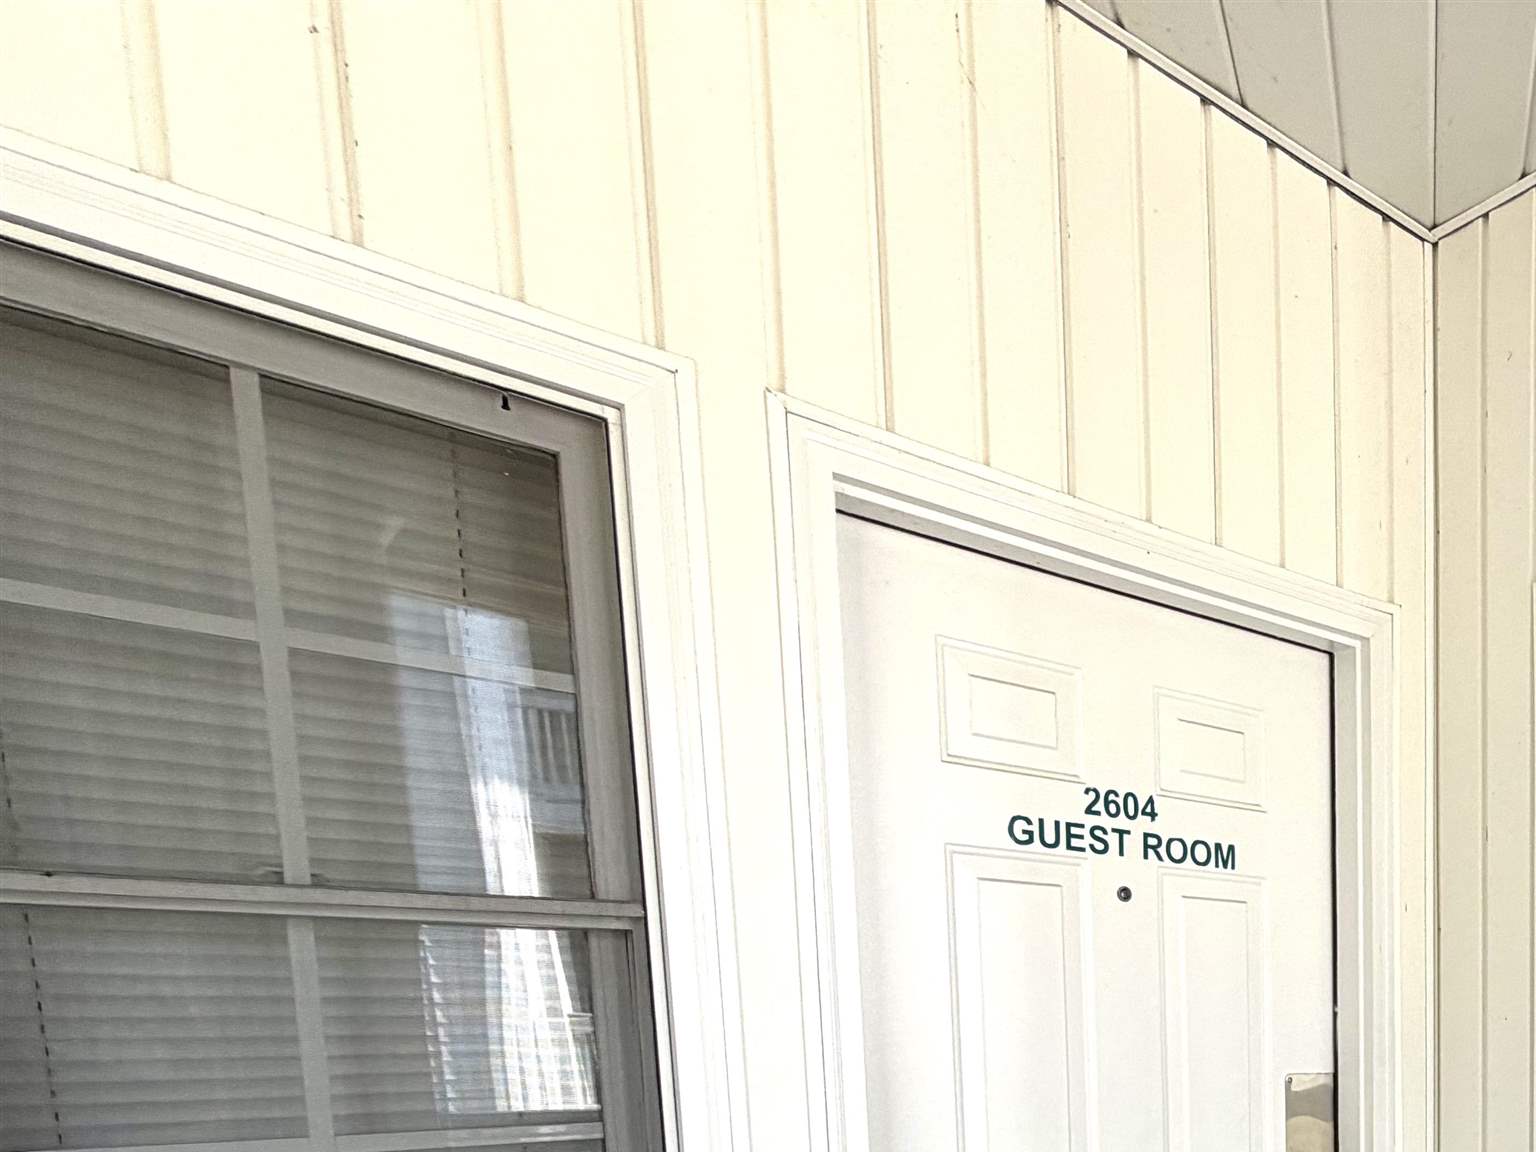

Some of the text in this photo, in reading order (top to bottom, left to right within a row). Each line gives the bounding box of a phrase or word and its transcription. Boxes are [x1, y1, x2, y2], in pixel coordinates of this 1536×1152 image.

[1084, 786, 1158, 823] 2604
[1007, 814, 1236, 870] GUEST ROOM
